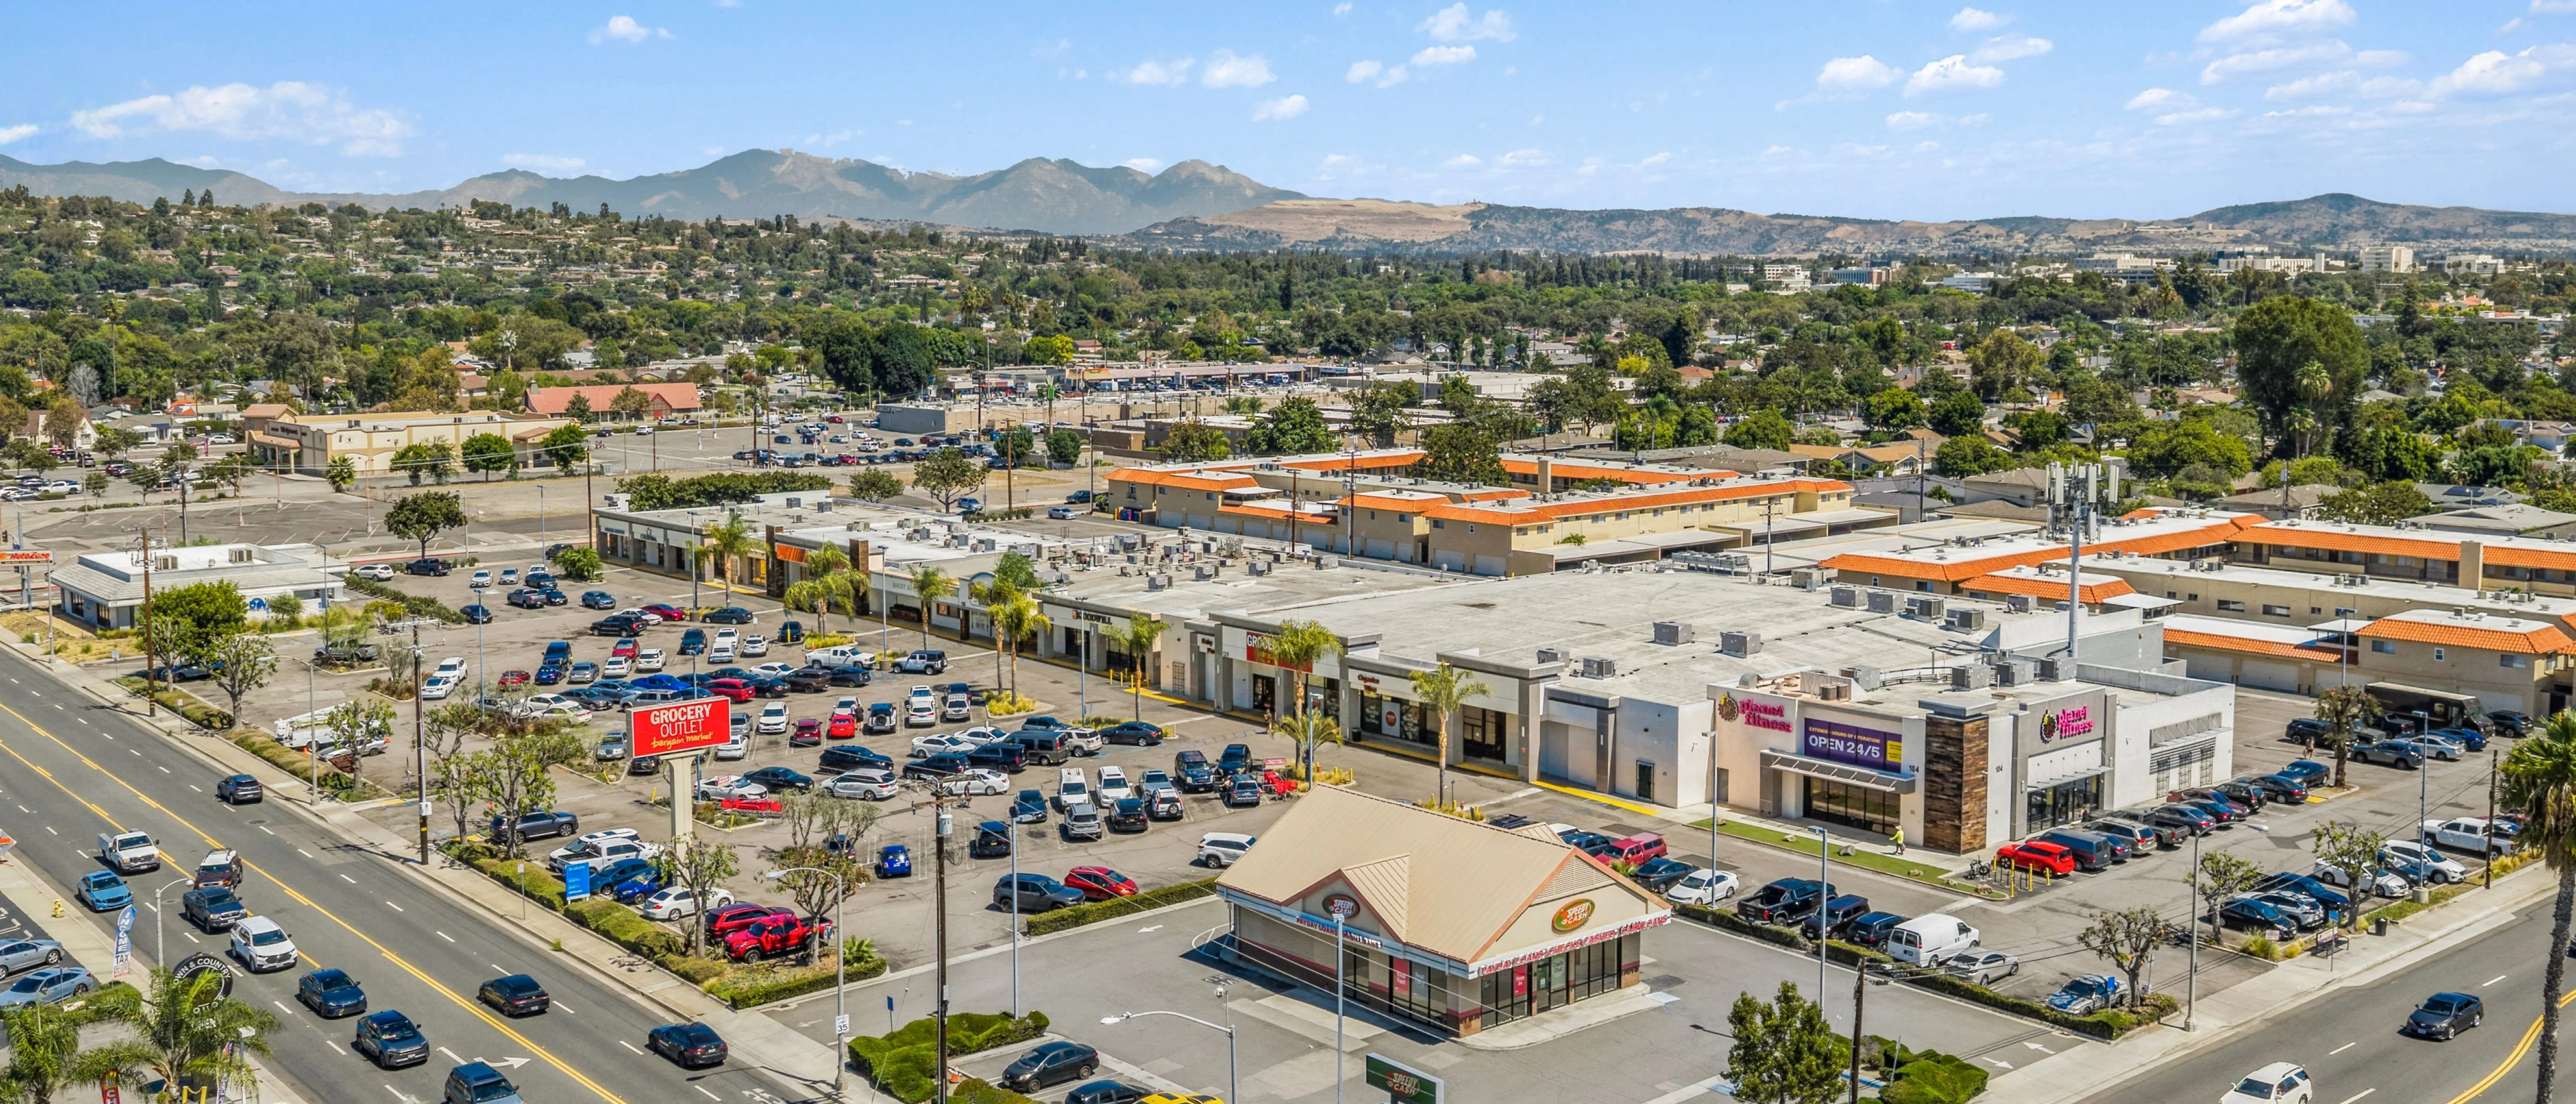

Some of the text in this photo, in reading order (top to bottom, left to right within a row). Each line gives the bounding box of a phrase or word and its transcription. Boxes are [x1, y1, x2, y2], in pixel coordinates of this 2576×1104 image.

[1078, 612, 1112, 625] GOODWILL
[650, 703, 712, 725] GROCERY
[1739, 699, 1785, 718] planet
[660, 718, 704, 737] OUTLET
[1744, 711, 1793, 733] fitness
[2060, 719, 2094, 738] fitness
[651, 731, 713, 749] bargain market
[1809, 735, 1844, 751] OPEN
[1847, 741, 1880, 758] 24/5
[1909, 765, 1919, 773] 104
[1334, 899, 1354, 910] SPEEDY
[1567, 902, 1590, 918] SPEEDY
[117, 911, 130, 952] INCOME
[1296, 917, 1318, 929] PAYDAY
[1319, 924, 1338, 936] LOANS
[1481, 915, 1668, 975] PAYDAY LOANS CHECKS CASHED CASH LOANS
[115, 954, 129, 965] TAX
[173, 965, 189, 985] OWN
[197, 958, 231, 978] COUNTRY
[838, 1024, 848, 1032] 35
[1393, 1072, 1419, 1088] SPEEDY
